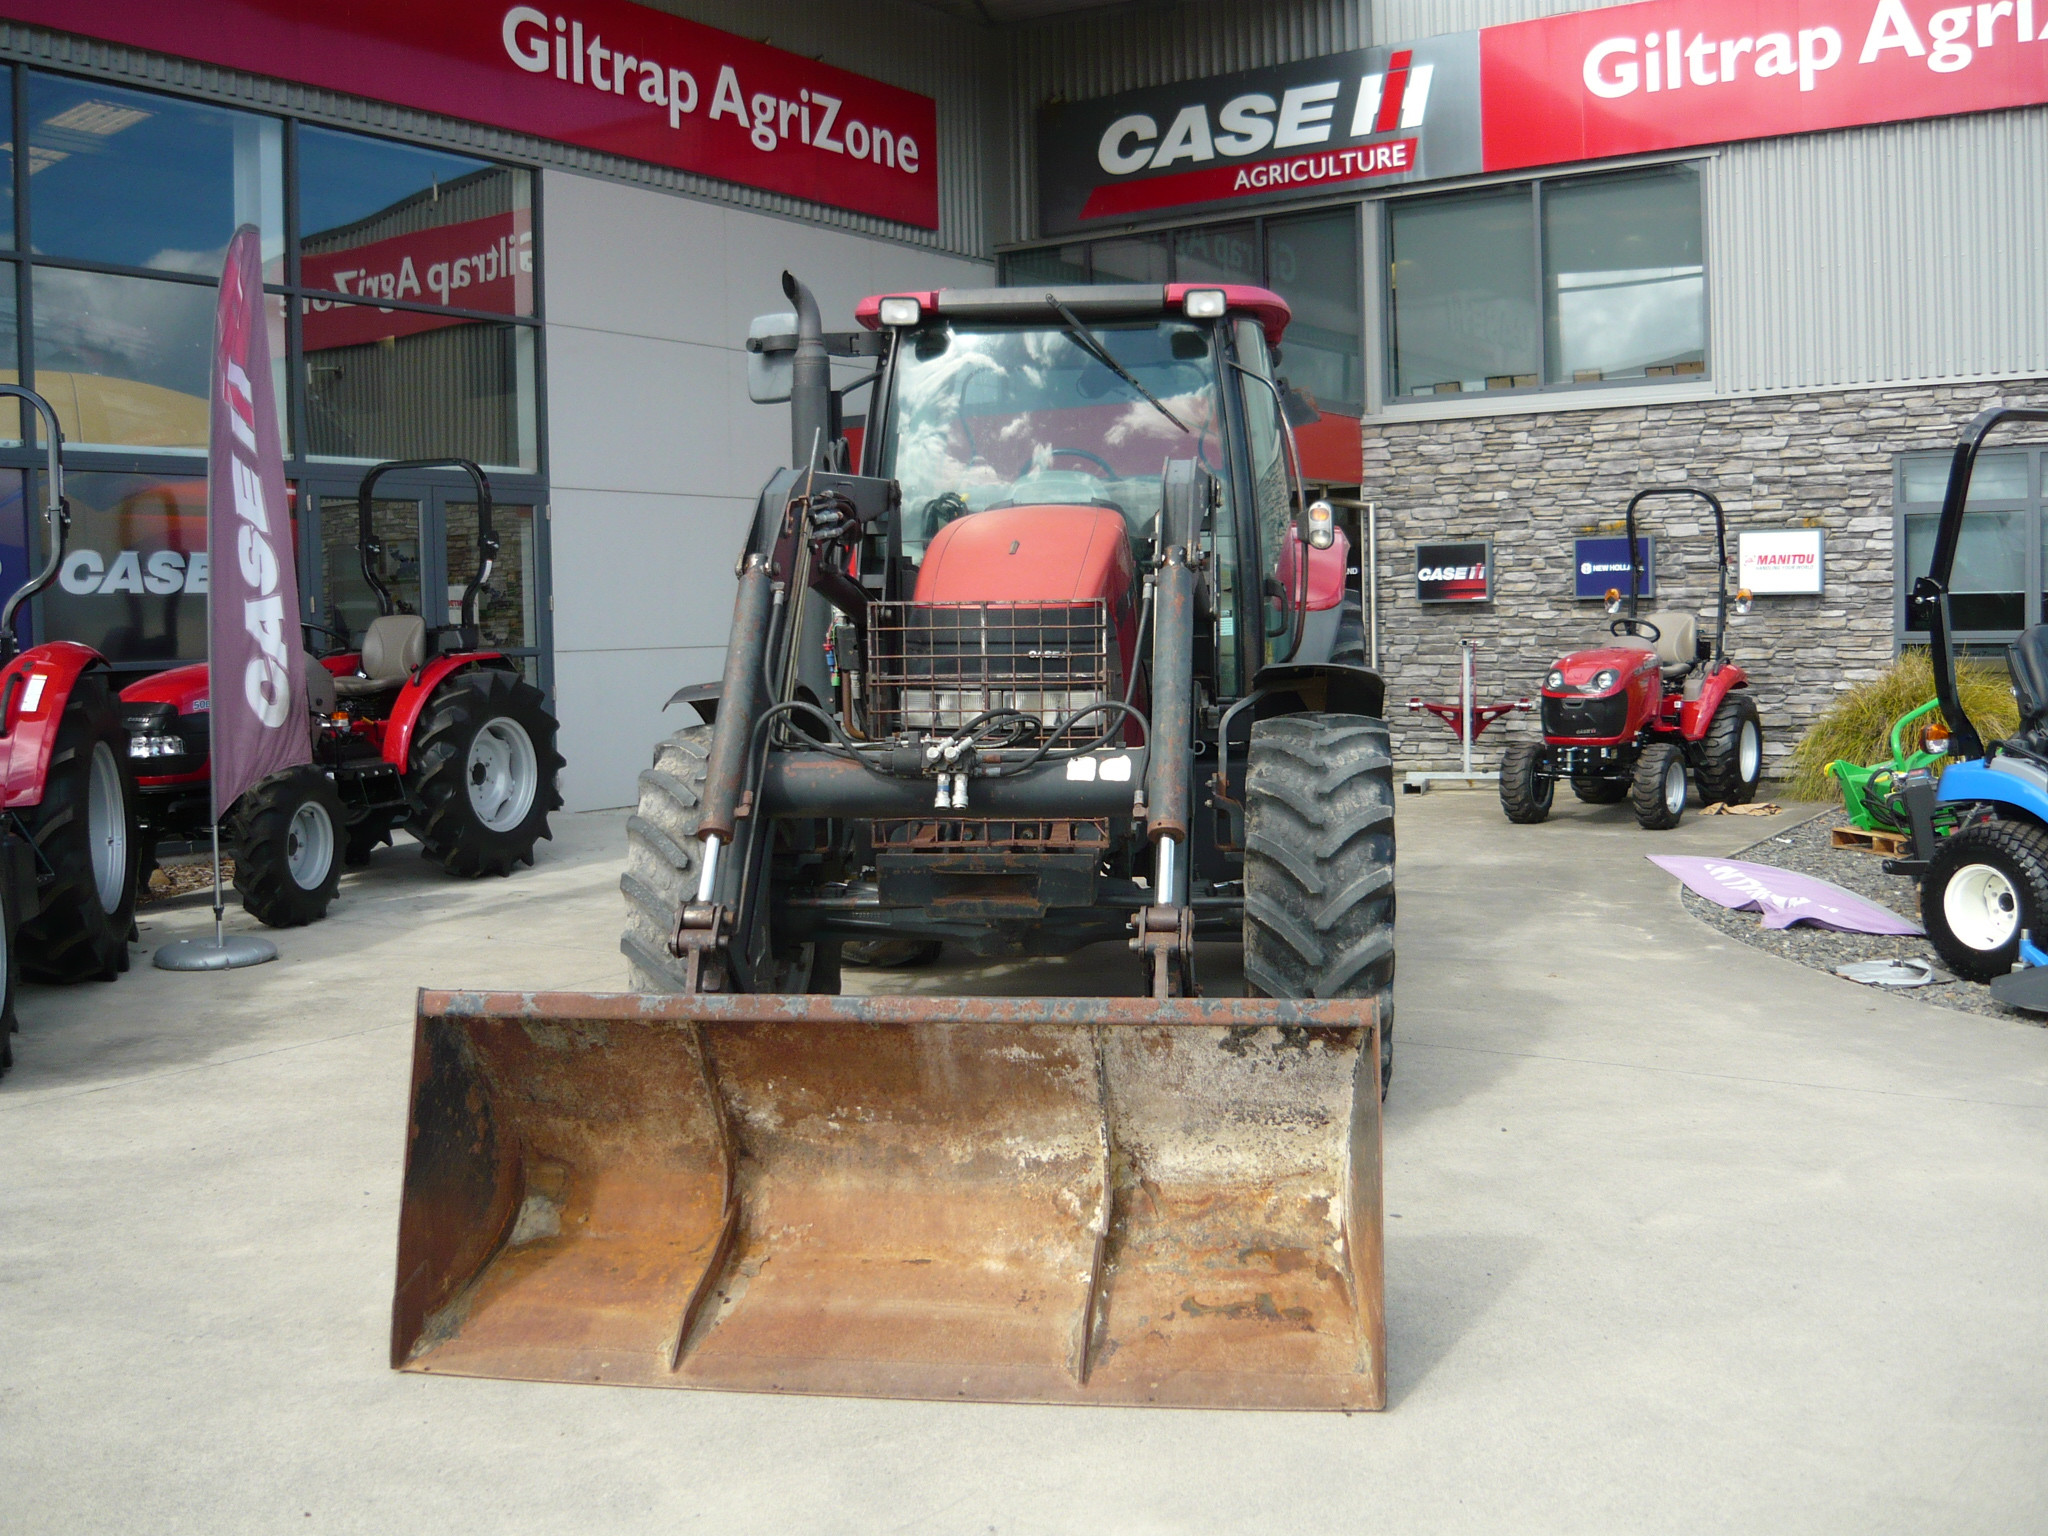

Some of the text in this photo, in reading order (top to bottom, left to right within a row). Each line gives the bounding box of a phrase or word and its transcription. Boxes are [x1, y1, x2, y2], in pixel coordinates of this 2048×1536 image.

[1582, 0, 2048, 99] Giltrap Agri
[502, 6, 919, 174] Giltrap AgriZone
[1098, 81, 1340, 175] CASE
[1234, 144, 1407, 191] AGRICULTURE
[59, 549, 208, 596] CASE
[231, 450, 290, 728] CASE
[1418, 567, 1466, 581] CASE
[1757, 554, 1815, 565] MANITOU
